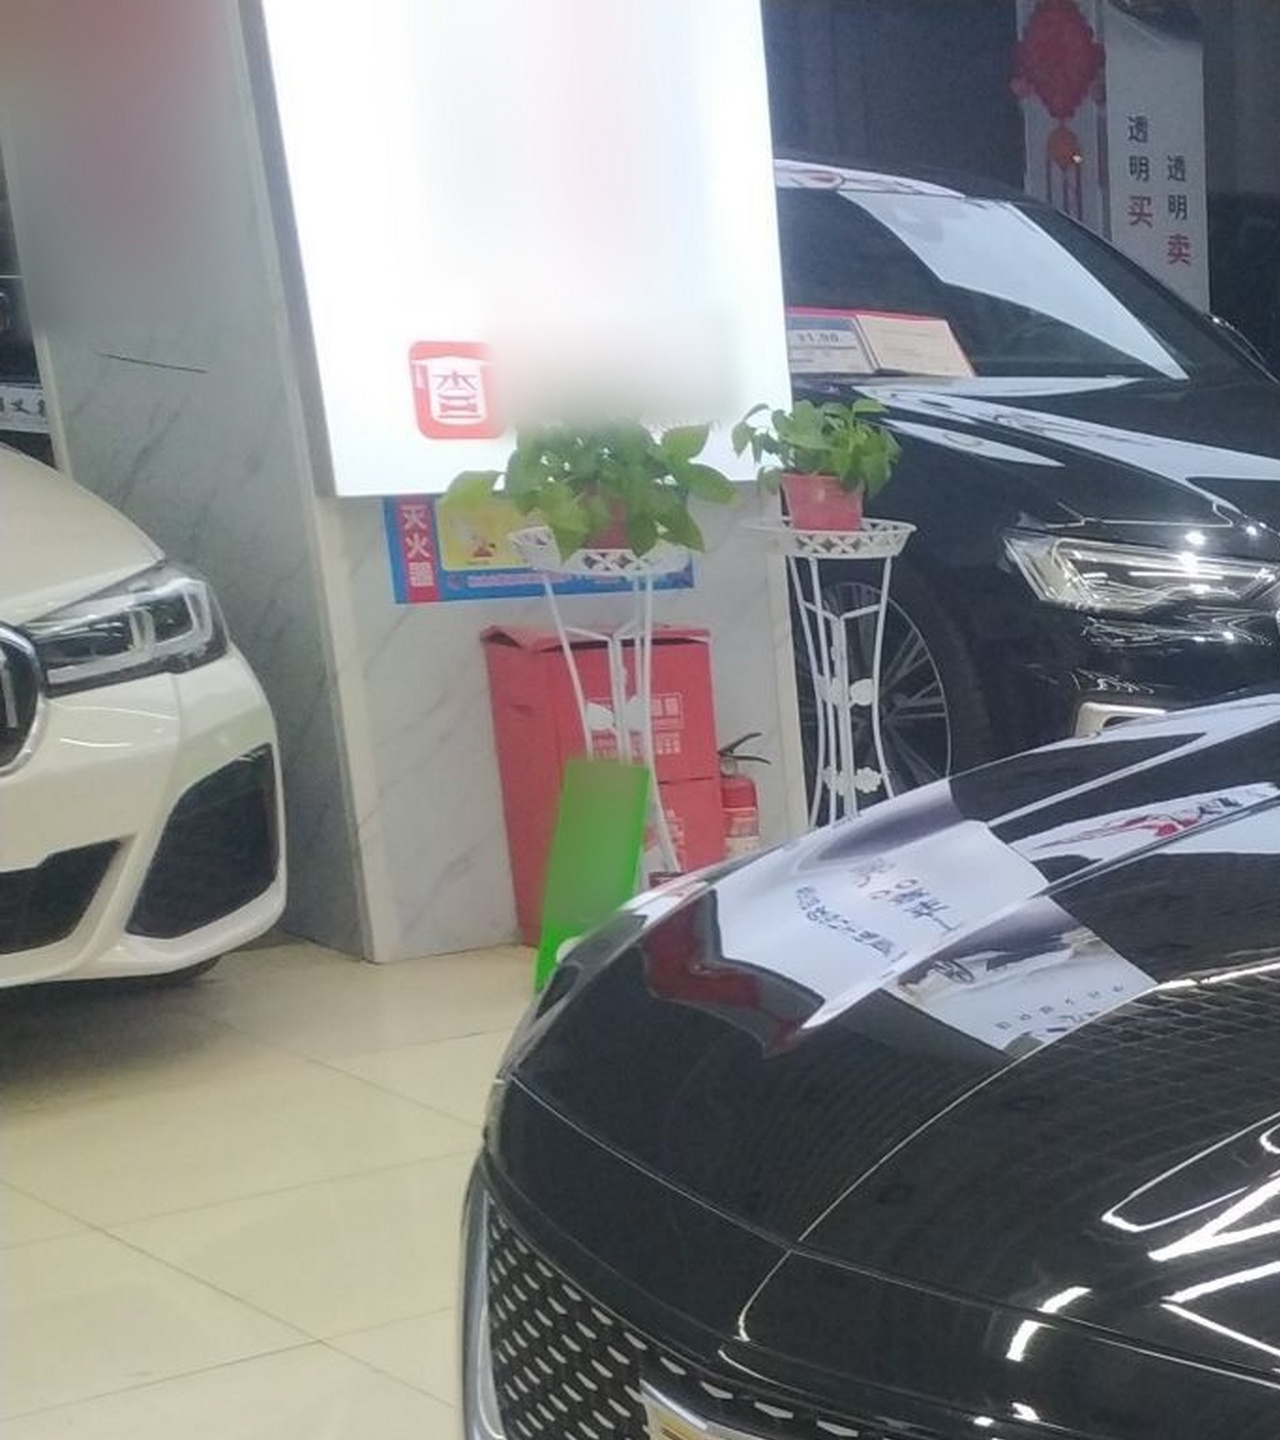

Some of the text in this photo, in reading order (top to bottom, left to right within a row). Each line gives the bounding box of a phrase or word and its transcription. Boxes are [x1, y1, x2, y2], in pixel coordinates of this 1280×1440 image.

[1127, 115, 1153, 228] 透明买
[1167, 154, 1192, 266] 透明卖
[402, 503, 436, 588] 灭火器
